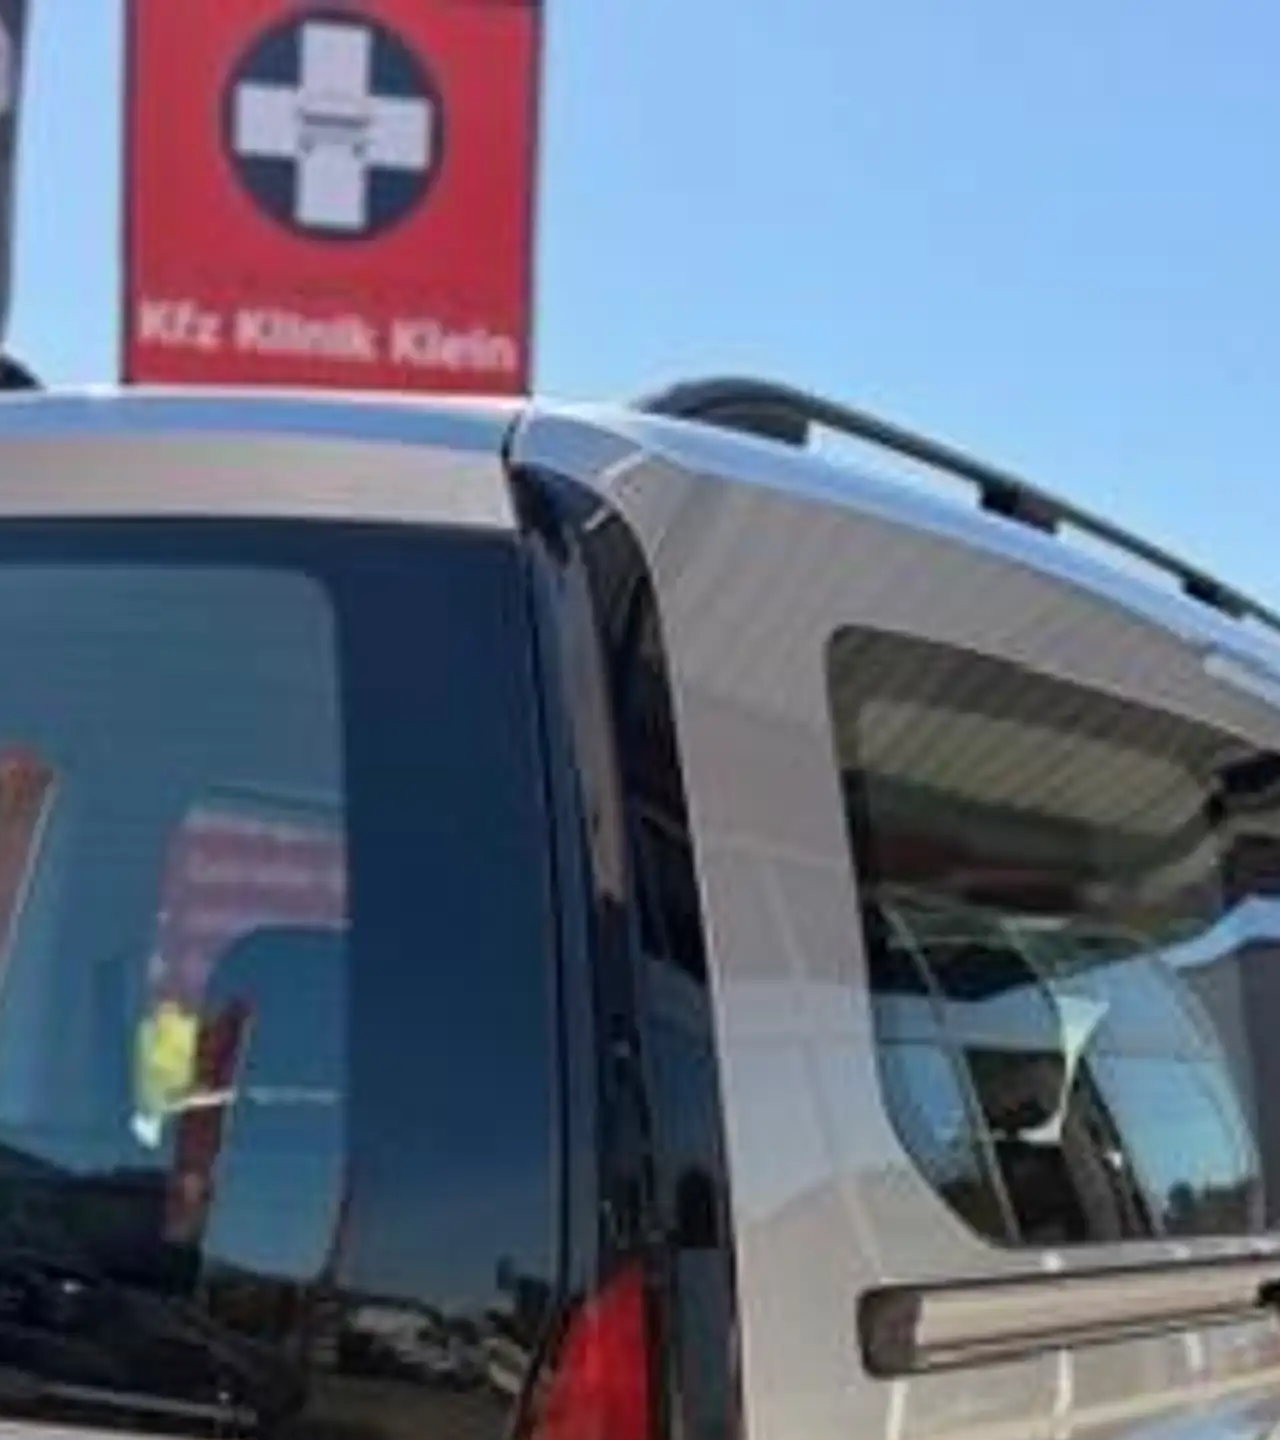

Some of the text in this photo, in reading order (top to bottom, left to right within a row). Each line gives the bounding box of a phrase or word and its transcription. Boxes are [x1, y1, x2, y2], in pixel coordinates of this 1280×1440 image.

[138, 297, 521, 373] Kfz Klinik Klein
